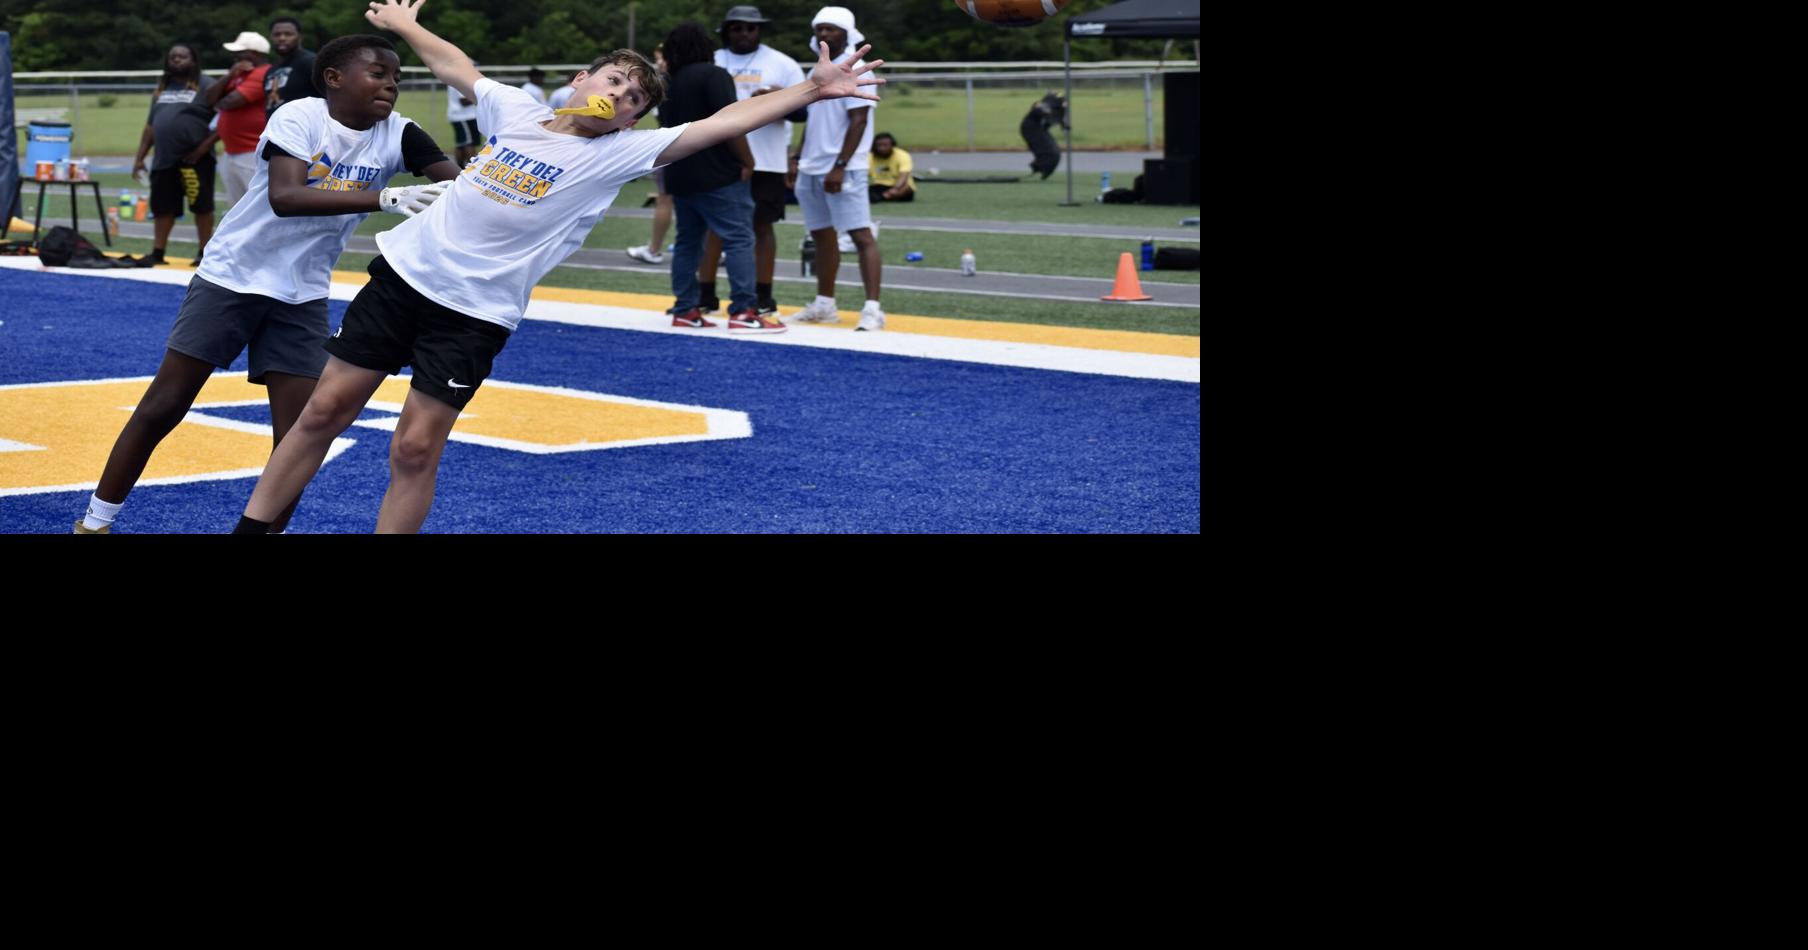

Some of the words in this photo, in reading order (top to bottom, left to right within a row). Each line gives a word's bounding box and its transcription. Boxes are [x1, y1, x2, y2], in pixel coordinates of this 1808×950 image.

[480, 159, 553, 198] GREEN
[495, 147, 564, 182] TREY'DEZ
[489, 184, 516, 201] FOOTBALL
[518, 197, 536, 206] CAMP
